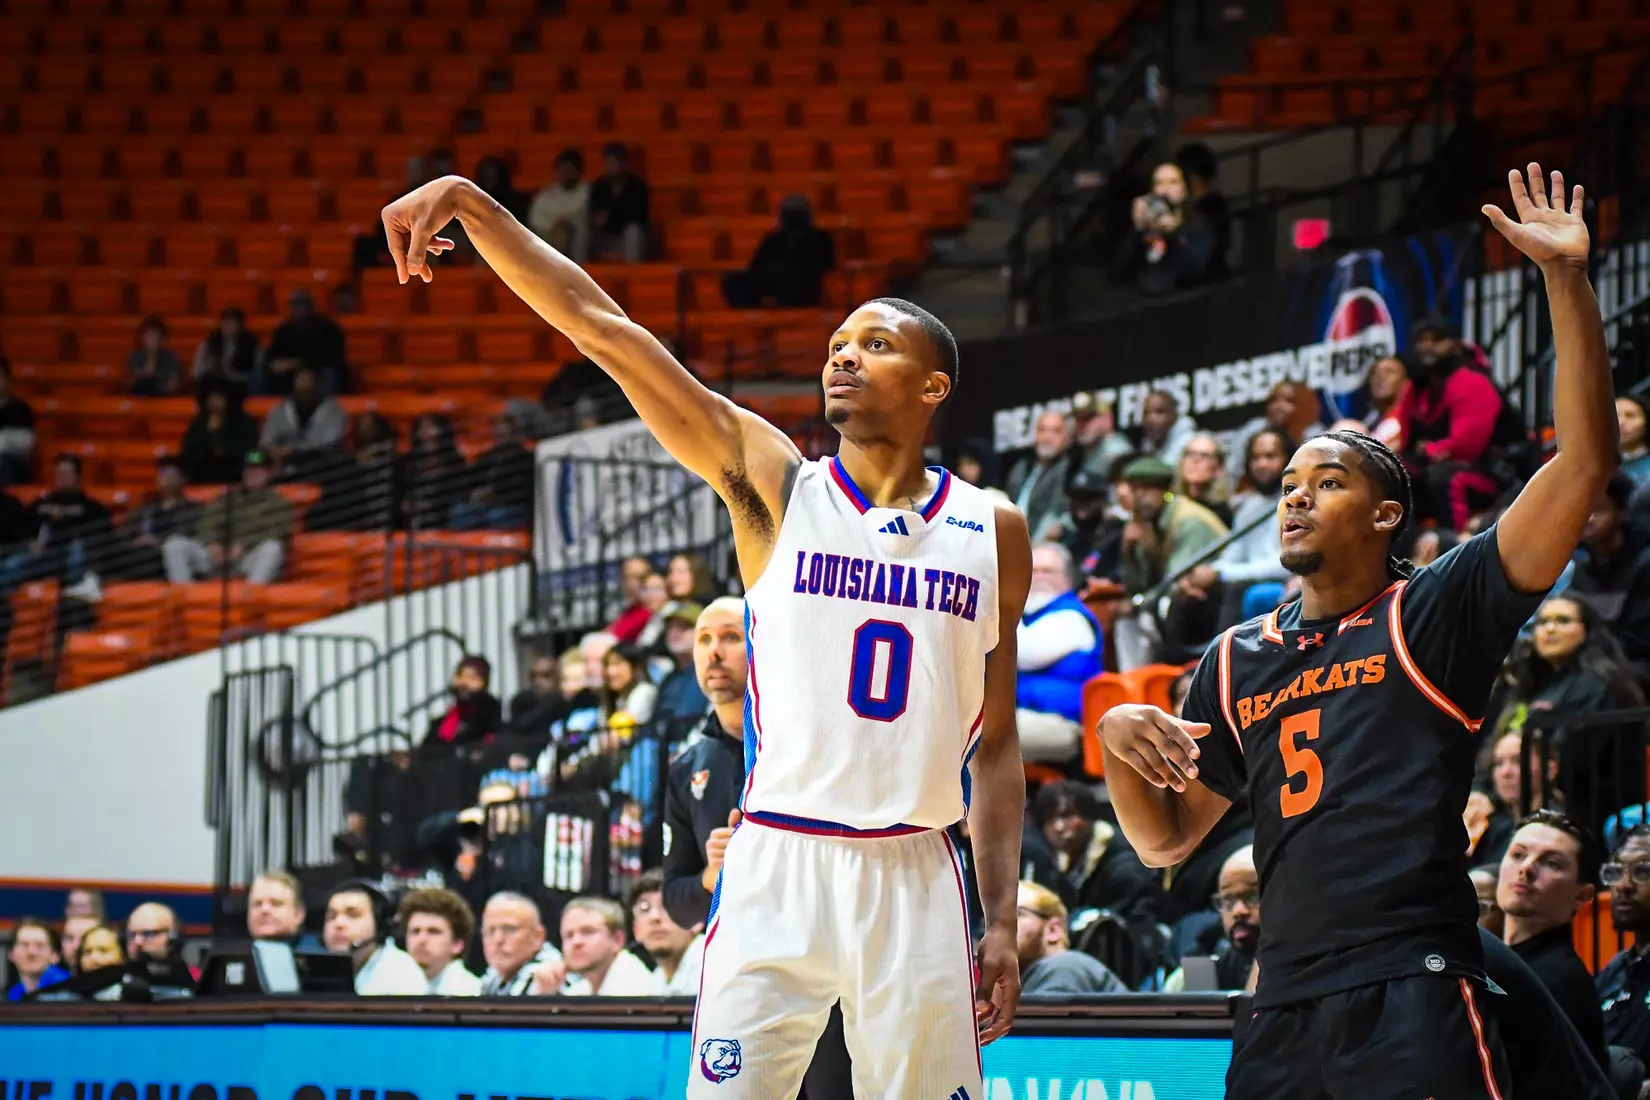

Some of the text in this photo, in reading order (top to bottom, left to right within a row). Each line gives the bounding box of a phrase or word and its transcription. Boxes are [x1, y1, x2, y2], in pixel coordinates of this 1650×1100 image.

[1192, 343, 1329, 415] DESERVE
[793, 550, 981, 622] LOUISIANA TECH
[847, 618, 914, 723] 0
[1278, 708, 1324, 819] 5
